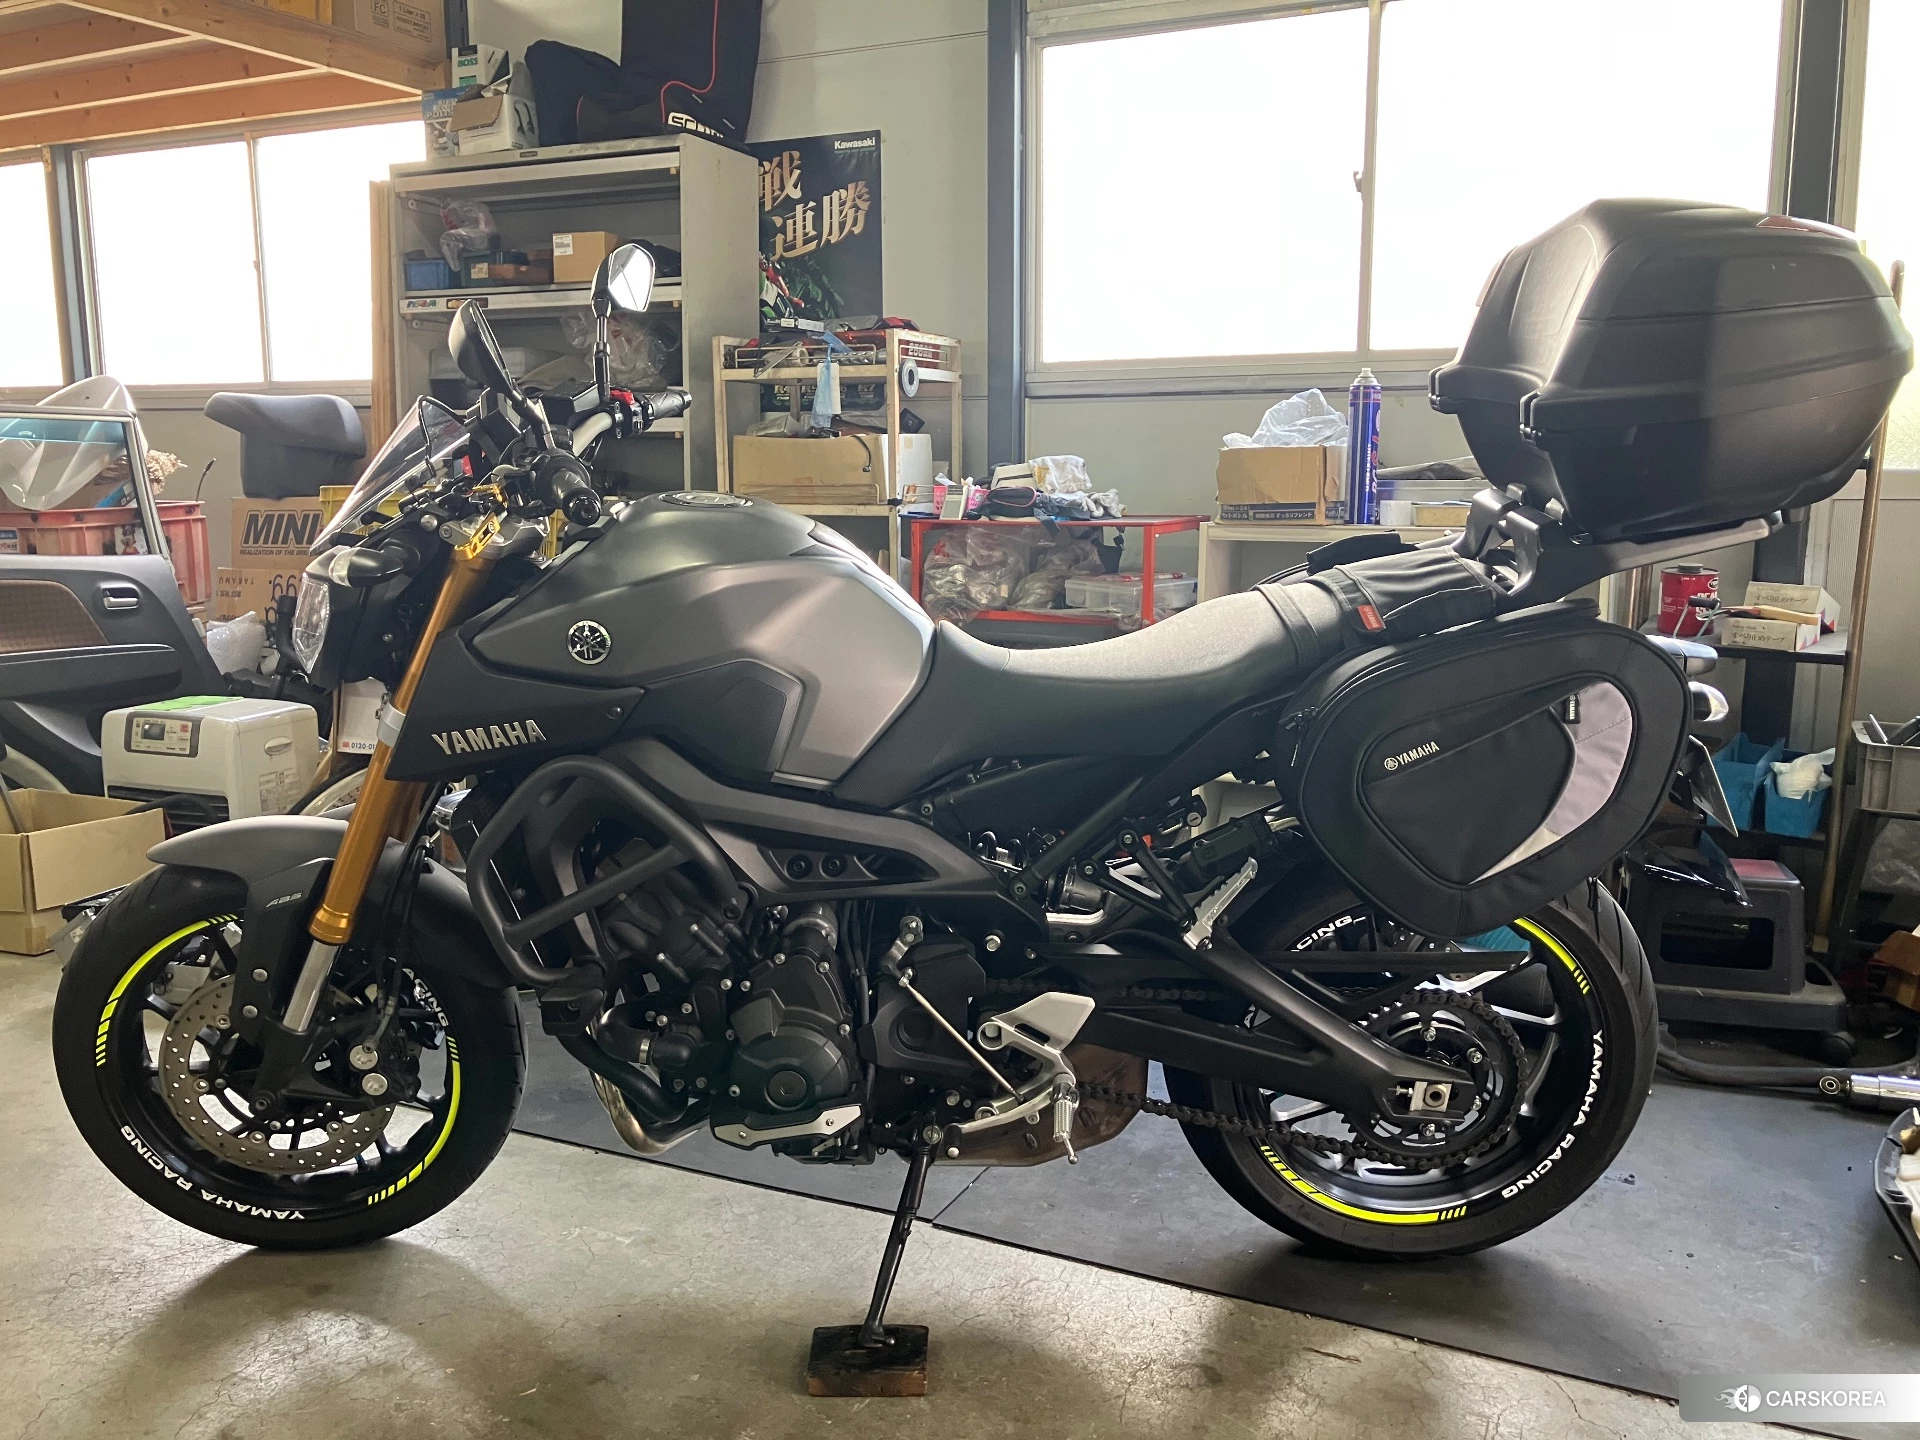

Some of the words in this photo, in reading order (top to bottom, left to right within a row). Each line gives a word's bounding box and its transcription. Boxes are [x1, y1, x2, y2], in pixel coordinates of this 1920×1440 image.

[426, 110, 454, 119] POLIS
[834, 137, 876, 150] Kawasaki
[769, 180, 873, 262] 連勝
[241, 510, 323, 548] MINI
[1731, 632, 1786, 644] すべり止めテープ
[431, 719, 547, 755] YAMAHA
[1396, 741, 1440, 766] YAMAHA
[1291, 915, 1354, 952] CING
[402, 968, 450, 1027] ACING
[1572, 1029, 1604, 1127] YAMAHA
[120, 1124, 194, 1191] RACING
[1501, 1132, 1576, 1199] RACING
[201, 1188, 305, 1220] YAMAHA
